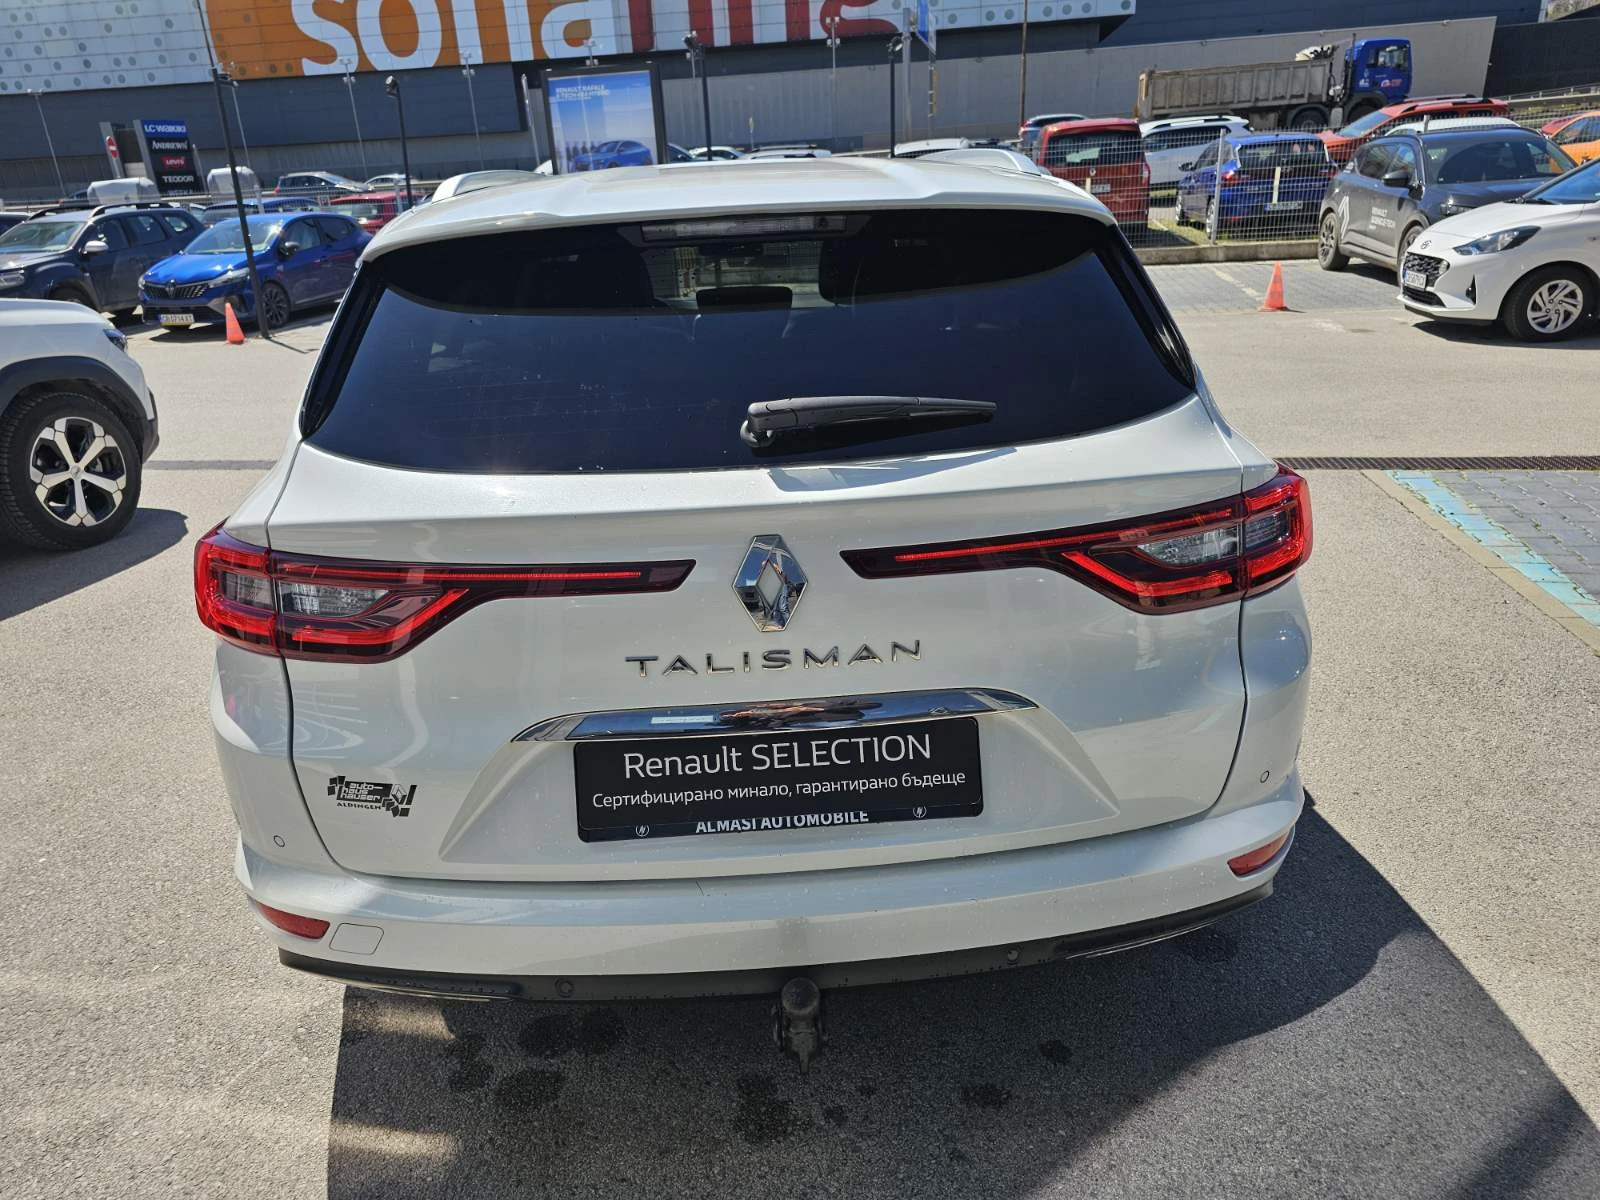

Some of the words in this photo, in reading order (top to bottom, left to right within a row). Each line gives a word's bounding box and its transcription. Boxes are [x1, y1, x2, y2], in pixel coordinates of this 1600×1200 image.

[144, 124, 155, 133] LC
[162, 175, 194, 183] TEODOR
[625, 639, 921, 678] TALISMAN
[624, 746, 742, 779] Renault
[751, 733, 931, 771] SELECTION
[341, 787, 369, 795] haus
[592, 786, 723, 811] Сертифицирано
[728, 781, 793, 801] минало,
[796, 774, 898, 798] гарантирано
[902, 769, 966, 790] бъдеще
[340, 793, 381, 801] hauser
[336, 802, 382, 810] ALDINGEN
[695, 817, 758, 834] ALMASI
[760, 810, 869, 830] AUTOMOBILE
